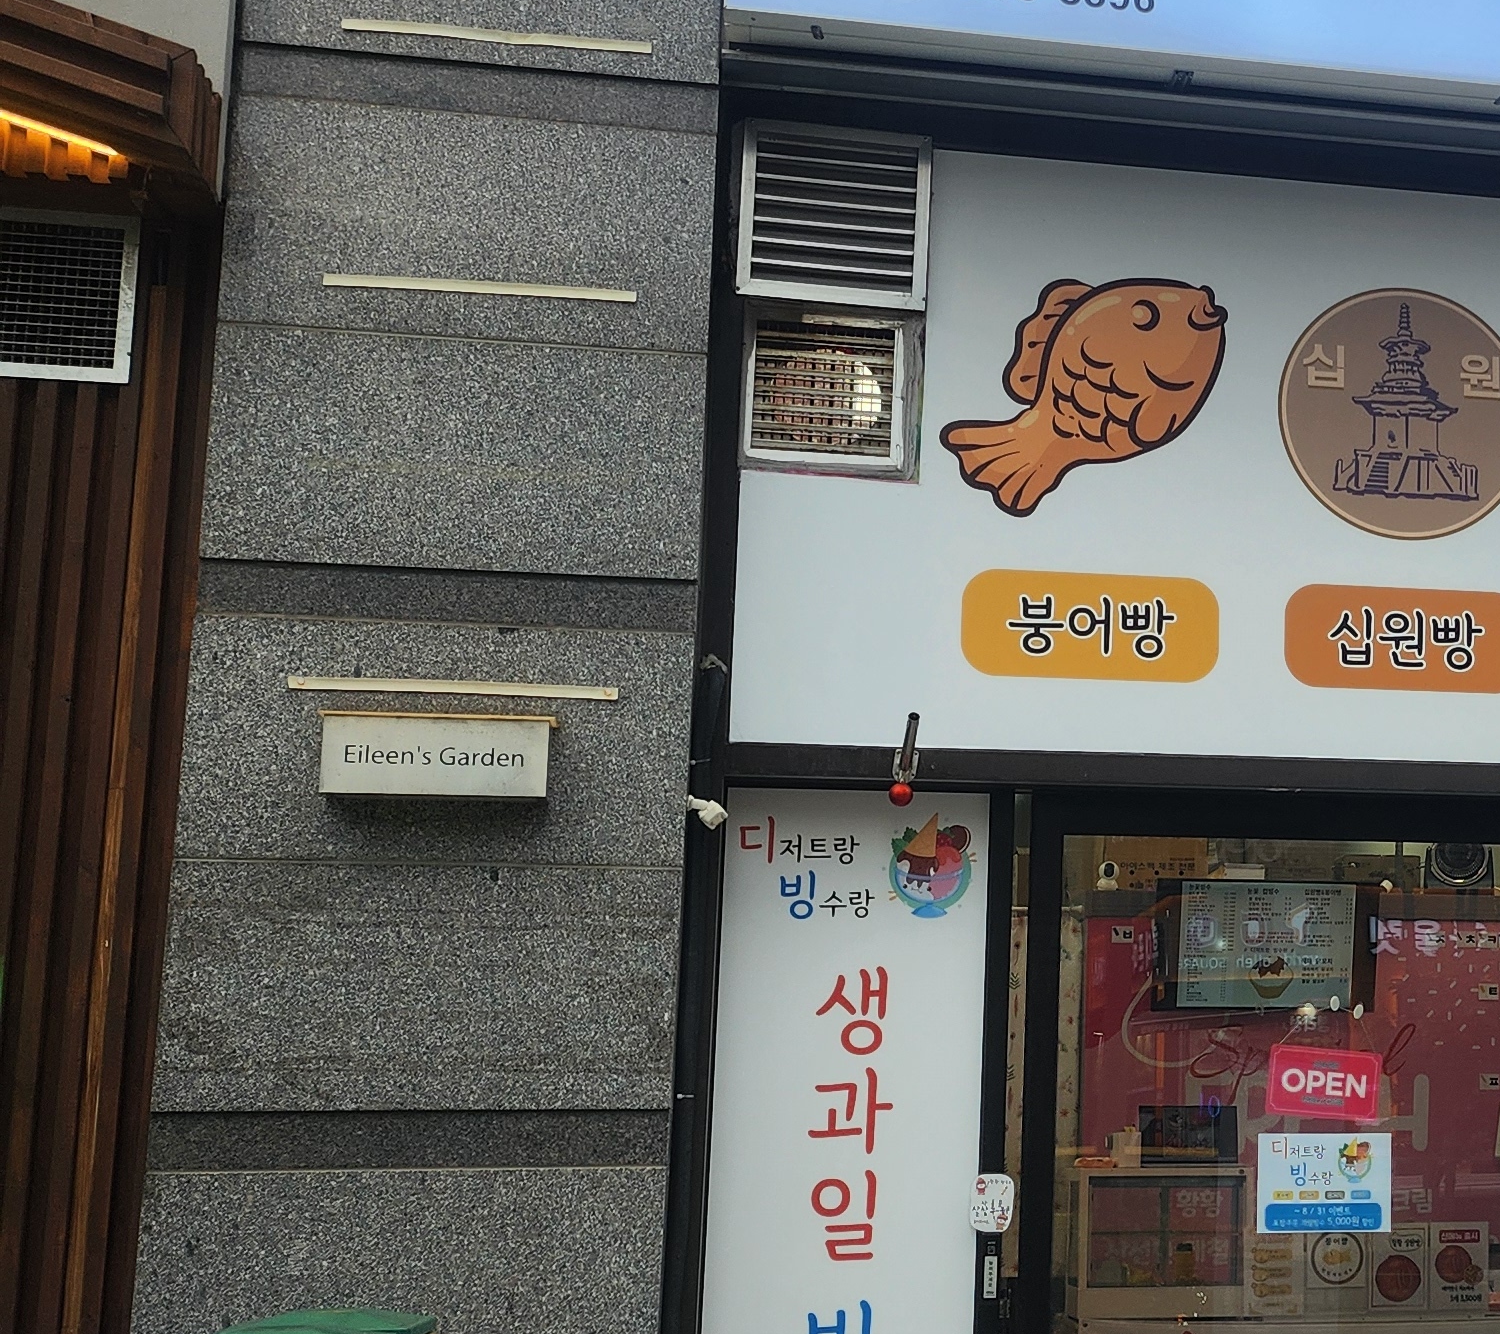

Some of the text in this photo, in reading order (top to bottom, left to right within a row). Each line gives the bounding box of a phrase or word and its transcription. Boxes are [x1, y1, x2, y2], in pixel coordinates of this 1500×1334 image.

[1302, 342, 1346, 391] 십
[1006, 592, 1178, 662] 붕어빵
[1326, 606, 1486, 674] 십원빵
[344, 744, 525, 768] Eileen's Garden
[739, 815, 861, 866] 디저트랑
[778, 869, 876, 920] 빙수랑
[1281, 1068, 1368, 1099] OPEN
[1271, 1137, 1326, 1160] 디저트랑
[1290, 1163, 1333, 1187] 빙수랑
